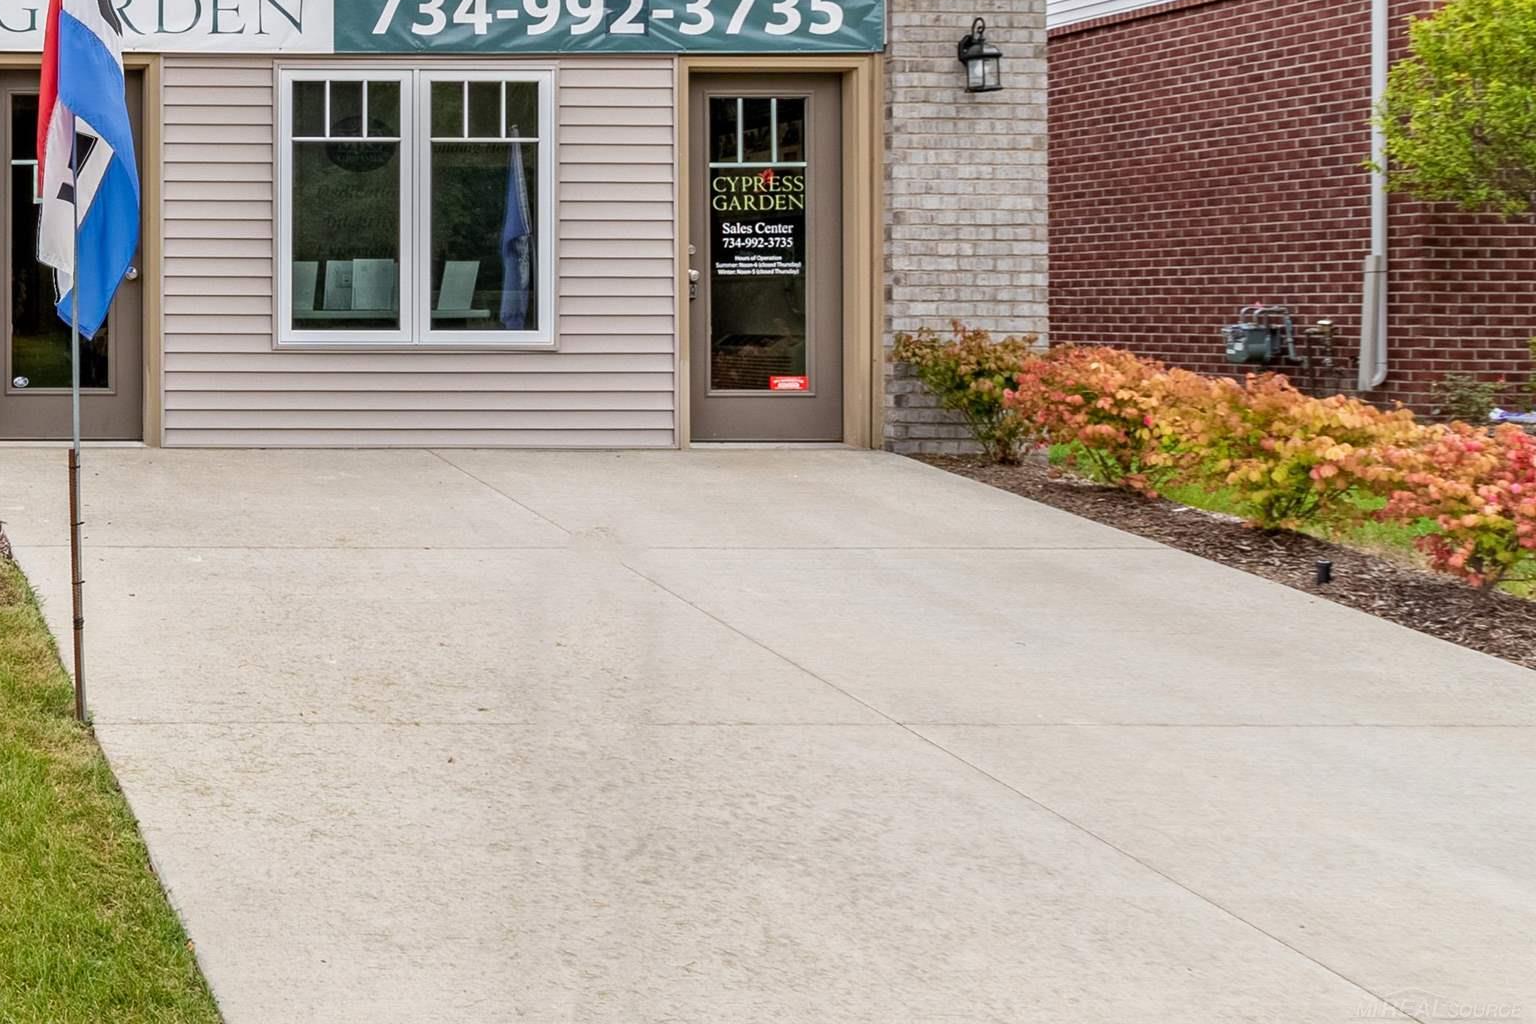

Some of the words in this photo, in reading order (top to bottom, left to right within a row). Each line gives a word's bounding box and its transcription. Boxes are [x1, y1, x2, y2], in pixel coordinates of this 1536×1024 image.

[712, 175, 804, 193] CYPRESS
[712, 194, 804, 211] GARDEN
[722, 222, 753, 234] Sales
[755, 222, 794, 234] Center
[722, 237, 794, 248] 734-992-3735
